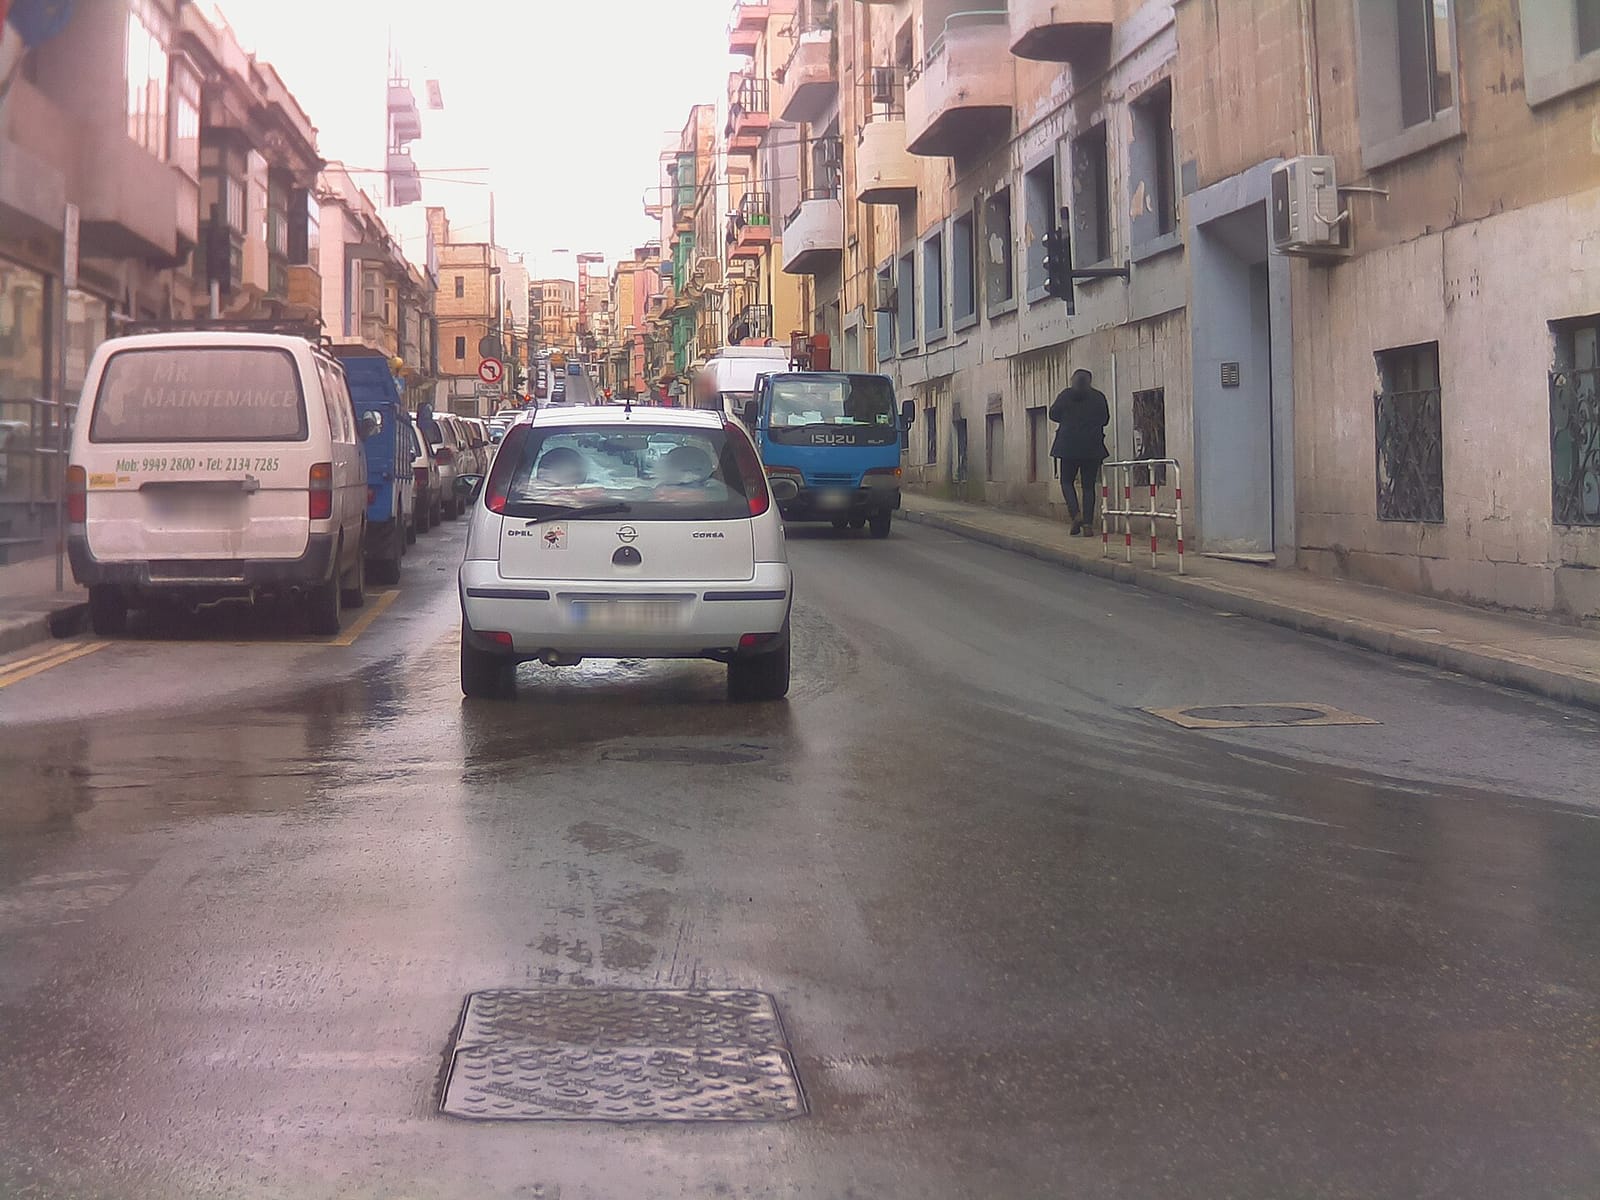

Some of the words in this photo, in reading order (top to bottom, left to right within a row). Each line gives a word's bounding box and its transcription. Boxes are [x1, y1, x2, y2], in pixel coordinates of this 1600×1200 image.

[142, 388, 297, 408] MAINTENANCE
[811, 434, 855, 444] ISUZU
[116, 458, 139, 472] Mob:
[142, 457, 167, 472] 9949
[170, 457, 195, 471] 2800
[206, 457, 223, 471] Tel:
[226, 457, 250, 471] 2134
[254, 457, 279, 471] 7285
